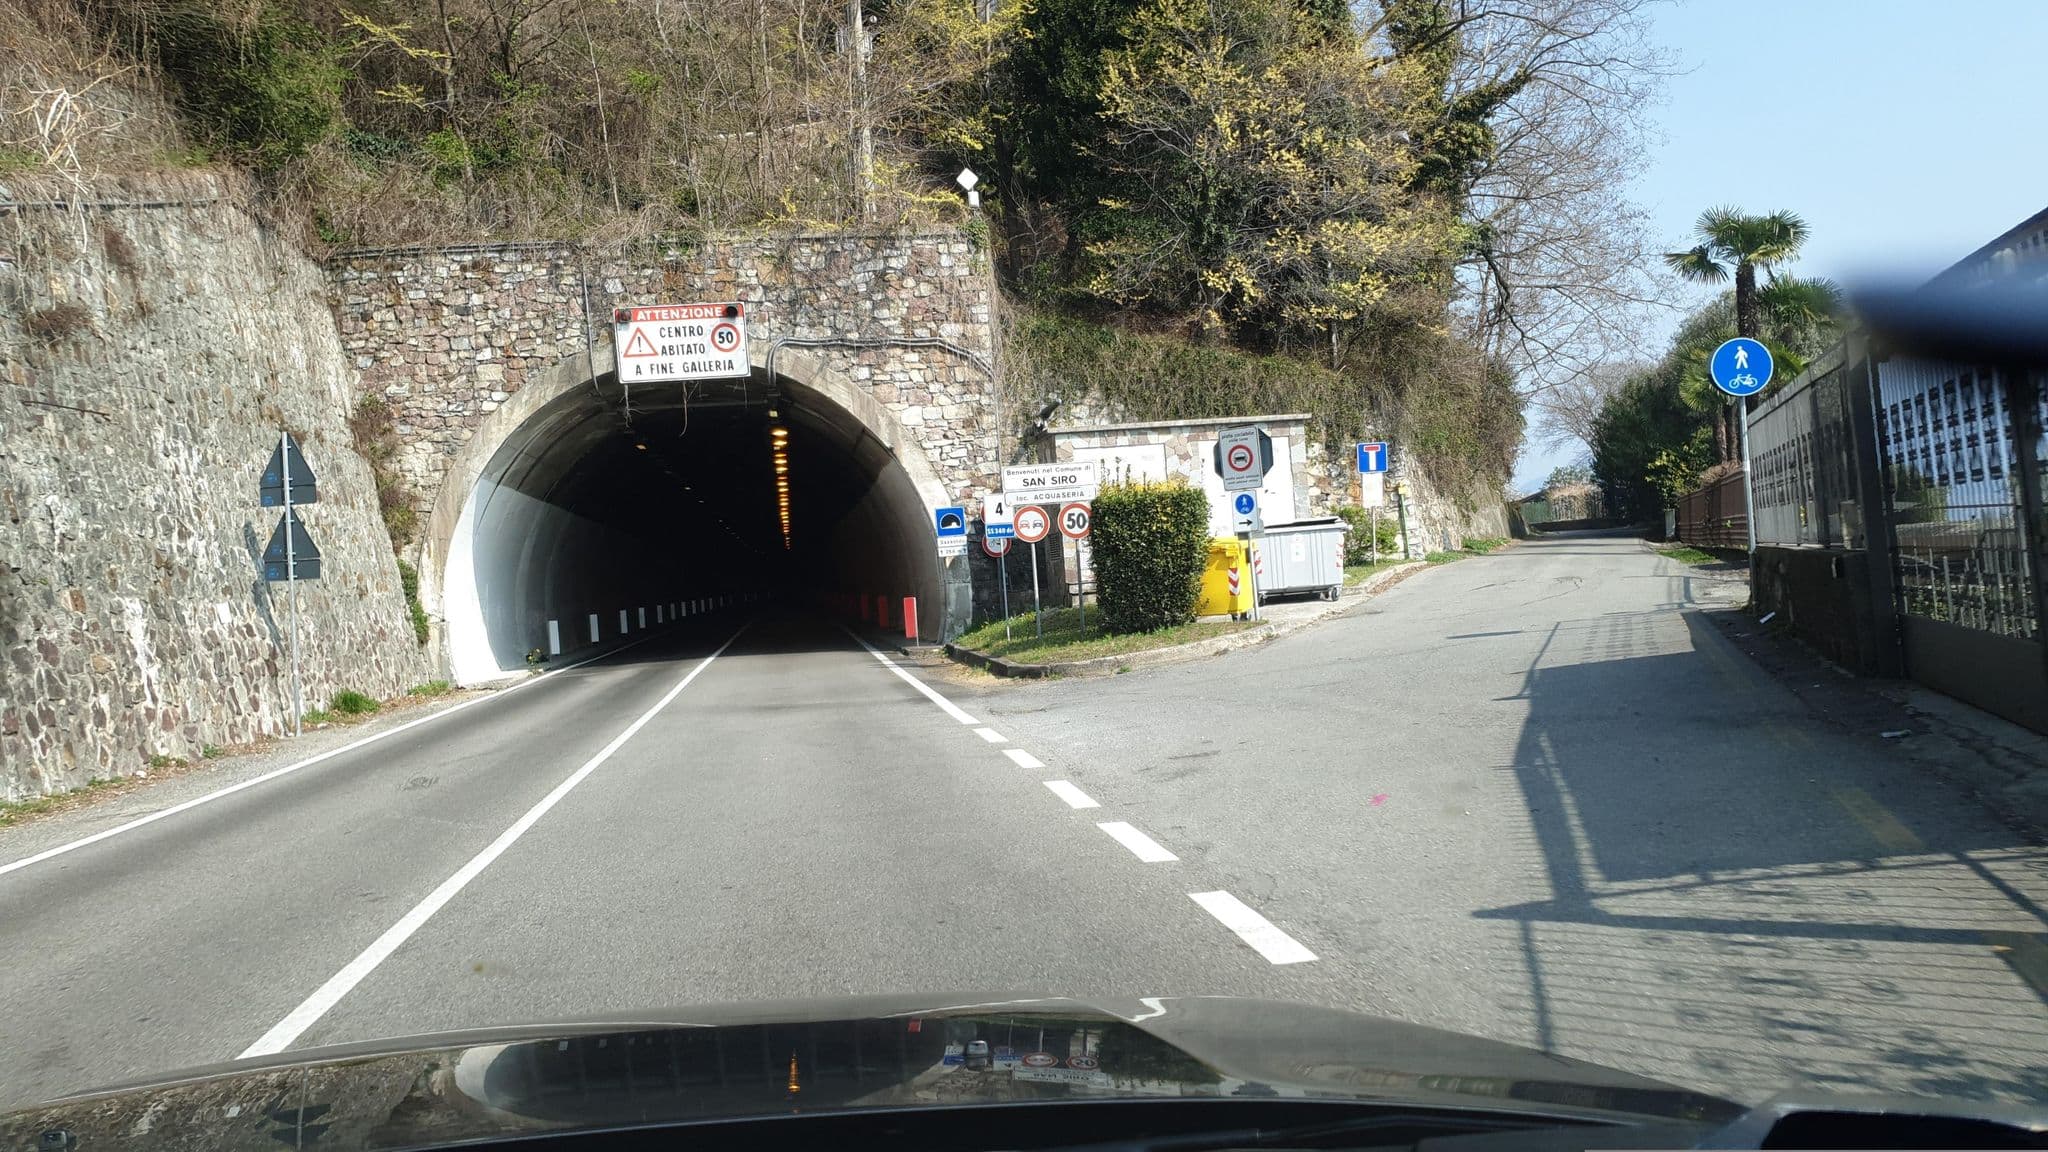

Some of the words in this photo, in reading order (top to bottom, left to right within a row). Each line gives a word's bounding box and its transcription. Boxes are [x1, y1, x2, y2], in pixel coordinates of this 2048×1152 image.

[637, 307, 723, 321] ATTENZIONE
[659, 325, 704, 338] CENTRO
[718, 331, 734, 344] 50
[661, 343, 705, 356] ABITATO
[635, 364, 642, 376] A
[650, 362, 675, 375] FINE
[682, 359, 735, 373] GALLERIA
[1006, 468, 1040, 476] Benvenuti
[1055, 465, 1082, 473] Comune
[1022, 477, 1046, 487] SAN
[1051, 475, 1077, 485] SIRO
[1034, 490, 1085, 500] ACQUASERIA
[995, 502, 1003, 516] 4
[1066, 512, 1087, 530] 50
